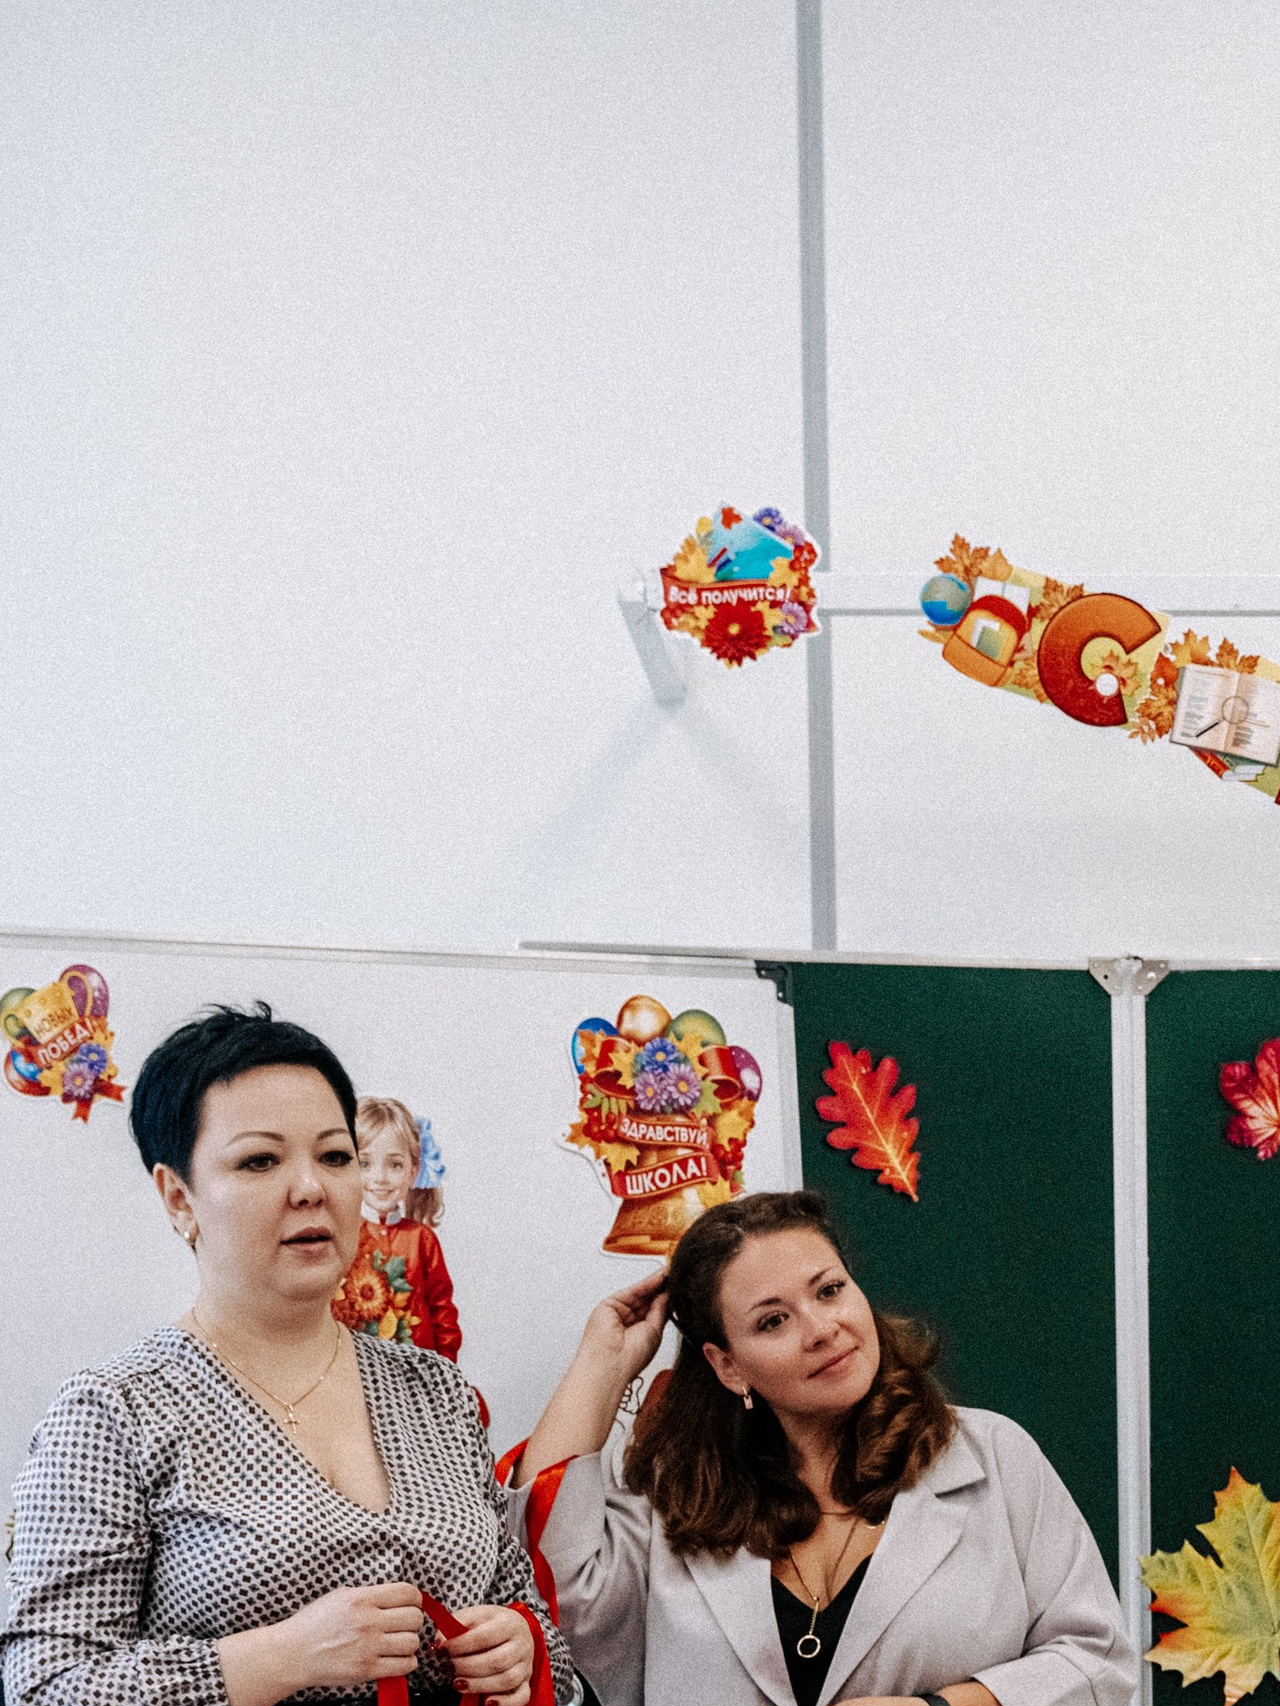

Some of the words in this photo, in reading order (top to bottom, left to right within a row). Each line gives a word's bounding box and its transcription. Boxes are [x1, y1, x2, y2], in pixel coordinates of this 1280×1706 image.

[1037, 592, 1161, 727] С
[38, 1017, 95, 1067] ПОБЕД!
[625, 1157, 708, 1195] ШКОЛА!
